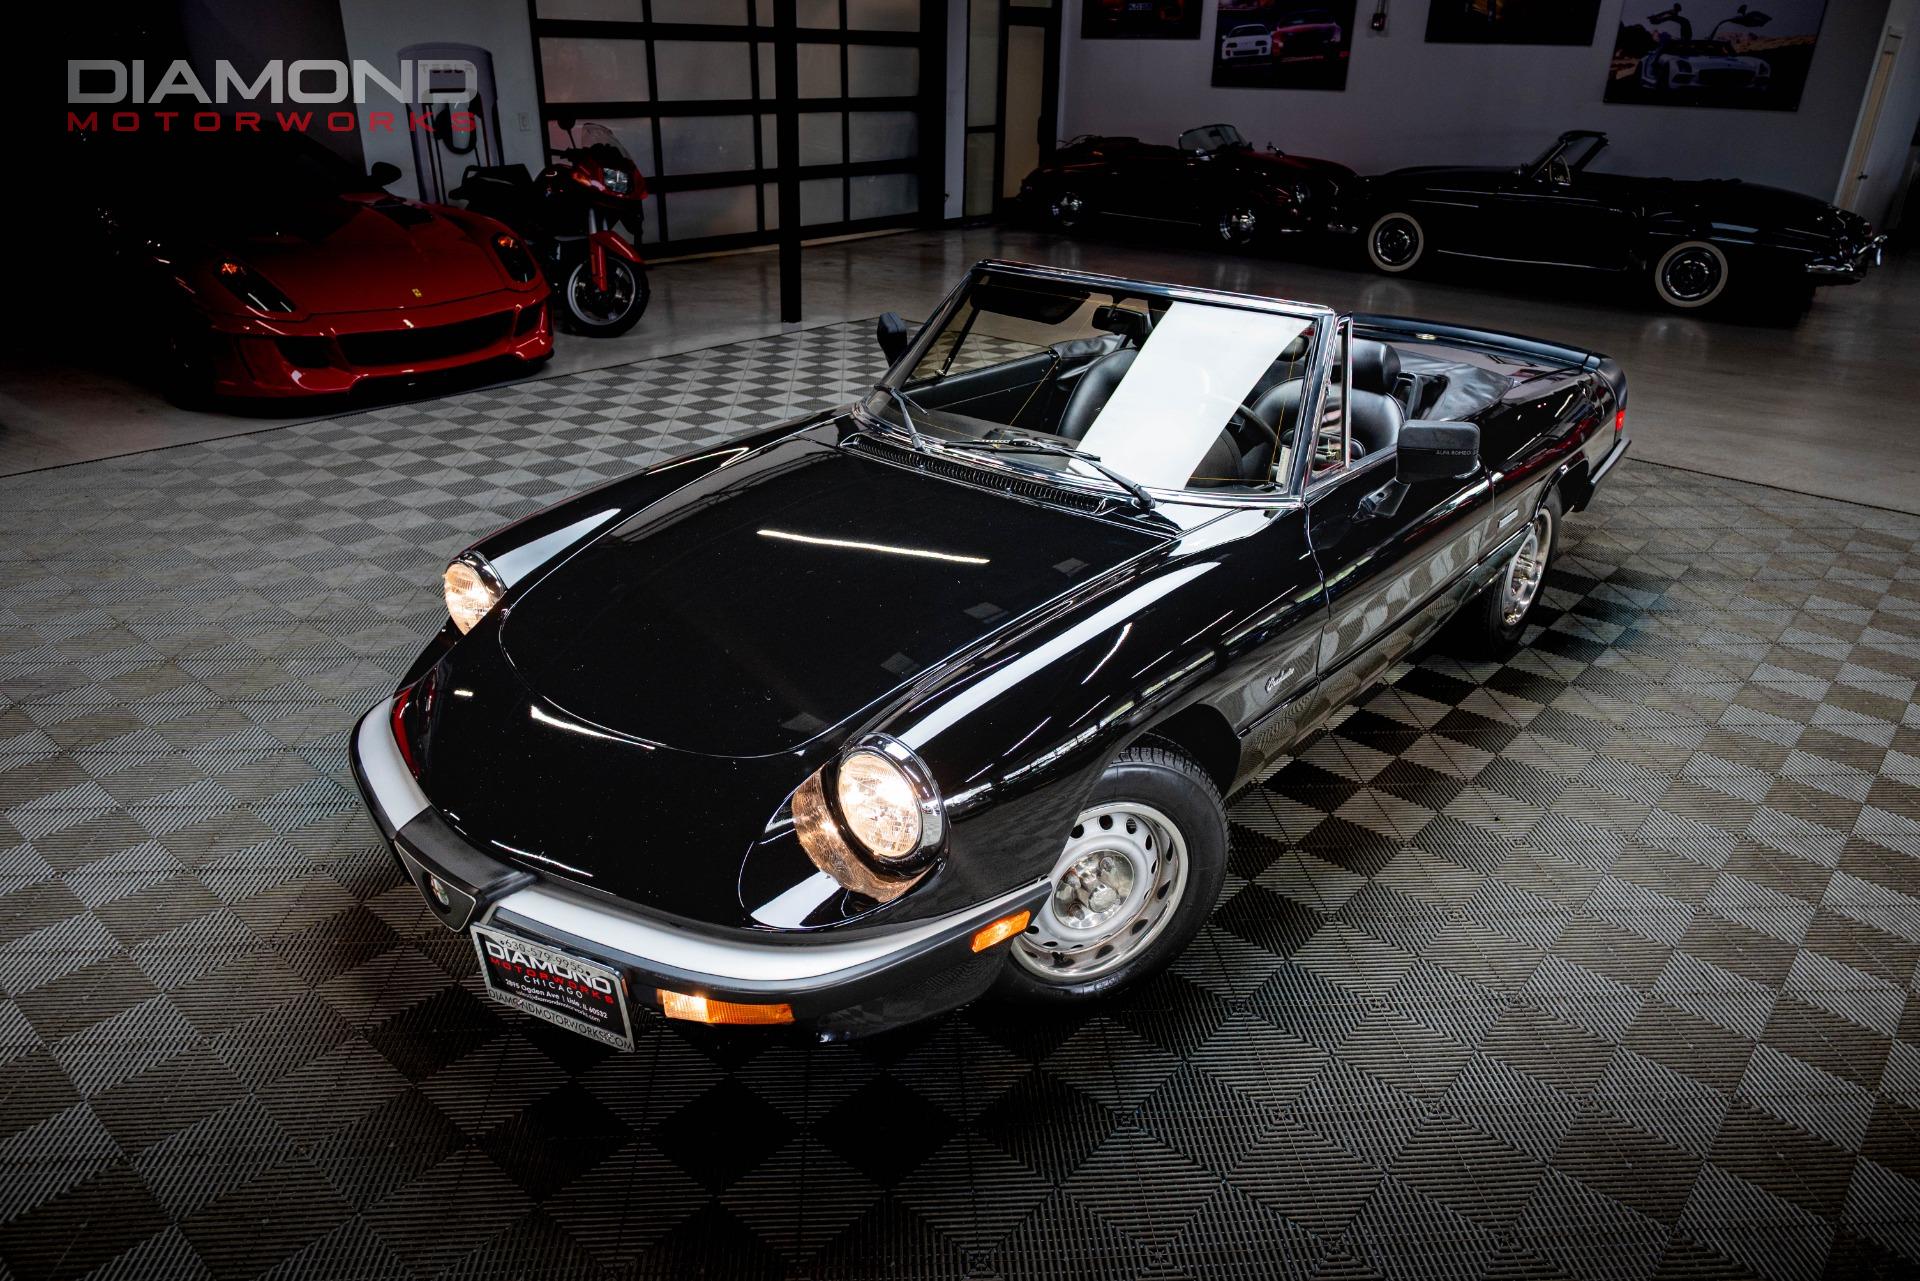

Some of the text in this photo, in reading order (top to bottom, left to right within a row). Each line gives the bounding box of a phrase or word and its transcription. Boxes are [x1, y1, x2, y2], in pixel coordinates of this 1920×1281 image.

[485, 940, 612, 994] DIAMOND
[488, 956, 614, 1004] MOTORWORKS
[521, 983, 545, 997] Ogden
[546, 990, 560, 999] Ave
[523, 975, 583, 999] CHICAGO
[489, 989, 634, 1051] DIAMONDMOTORWORKSCOM
